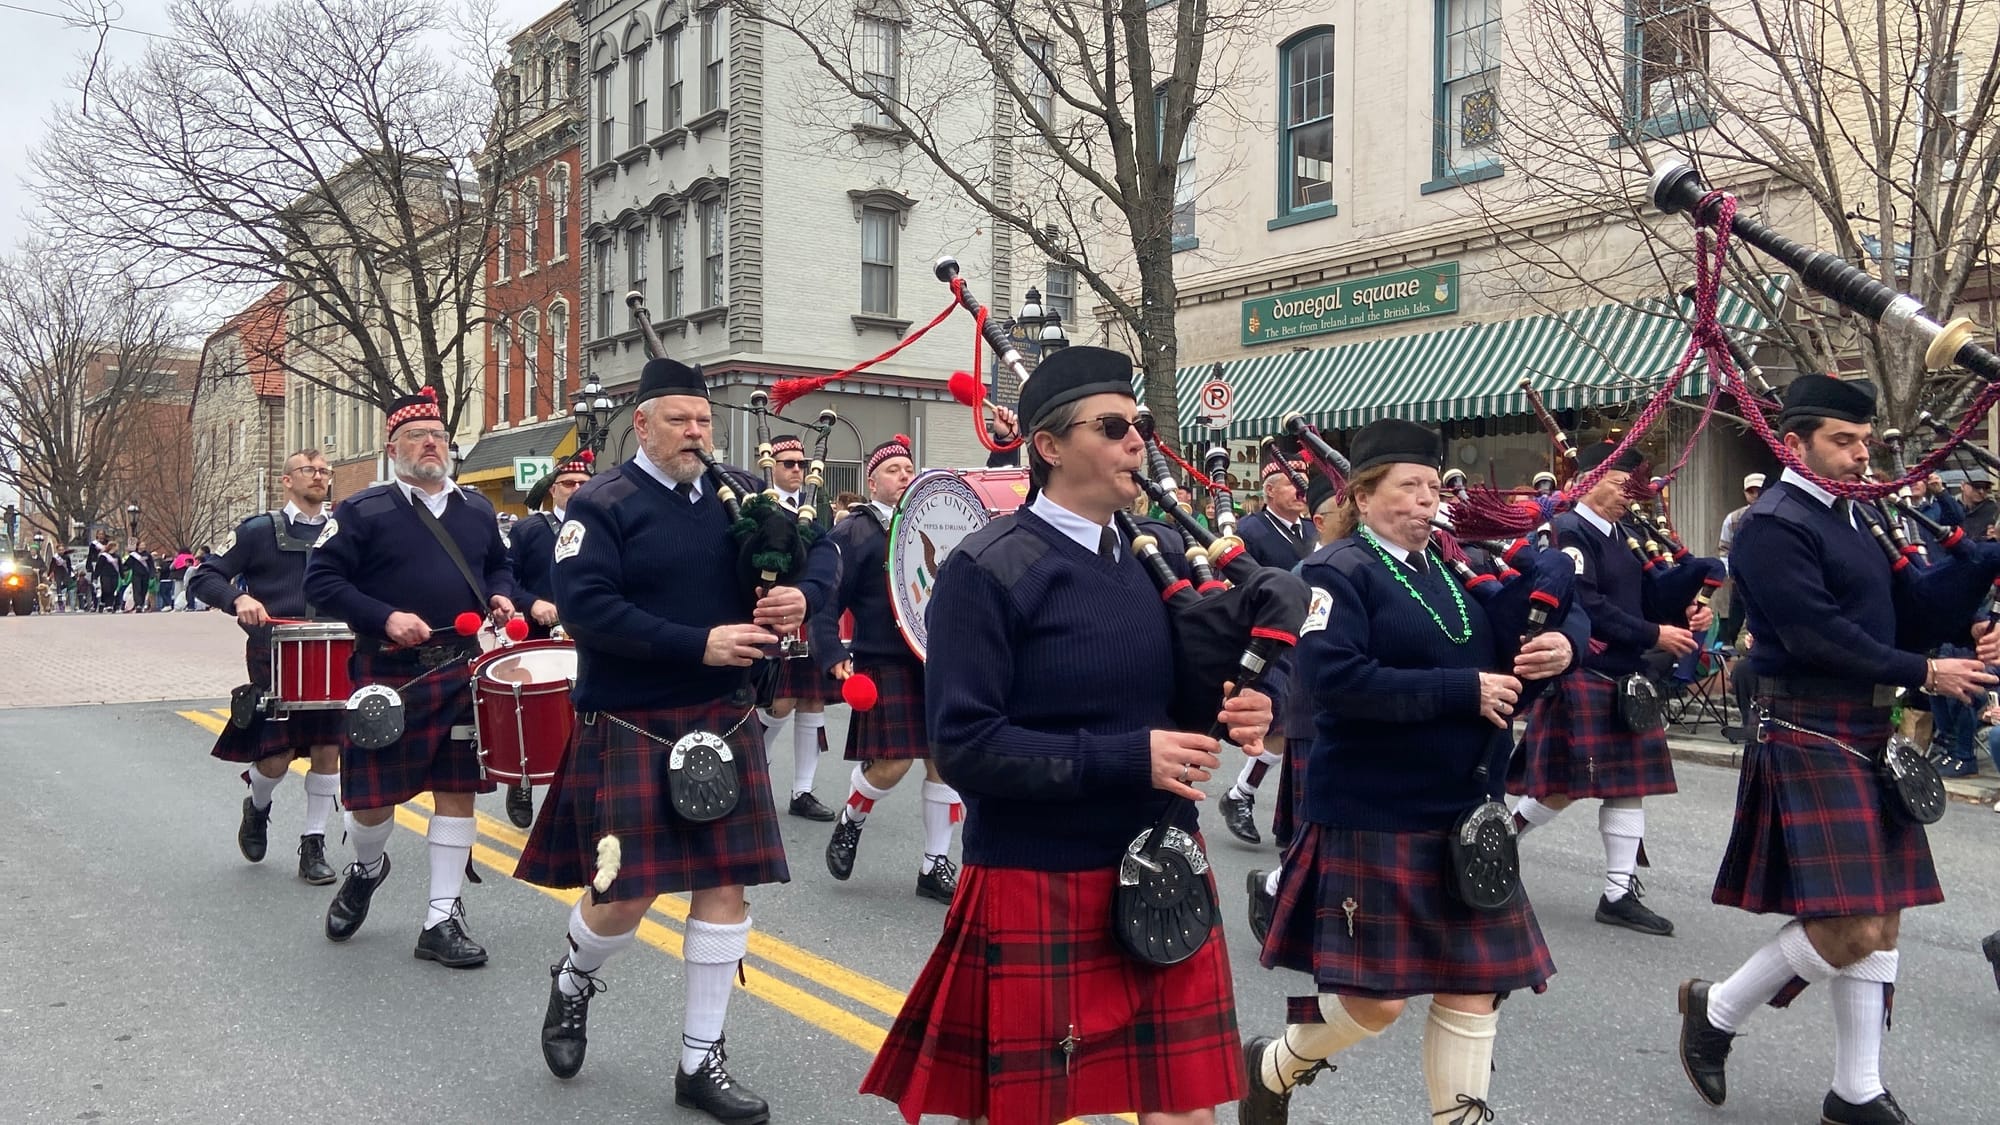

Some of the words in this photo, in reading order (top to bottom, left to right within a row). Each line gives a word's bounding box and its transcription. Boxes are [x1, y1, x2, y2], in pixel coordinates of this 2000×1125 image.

[1273, 287, 1342, 320] donegal
[1352, 278, 1420, 310] square
[1265, 328, 1280, 338] The
[1282, 325, 1297, 336] Best
[1300, 322, 1318, 333] from
[1321, 315, 1347, 329] Ireland
[1350, 312, 1364, 324] and
[1367, 310, 1380, 321] the
[1383, 304, 1410, 319] British
[1413, 301, 1431, 314] Isles
[520, 463, 538, 484] P
[908, 496, 938, 545] CELTIC
[945, 523, 967, 531] DRUMS
